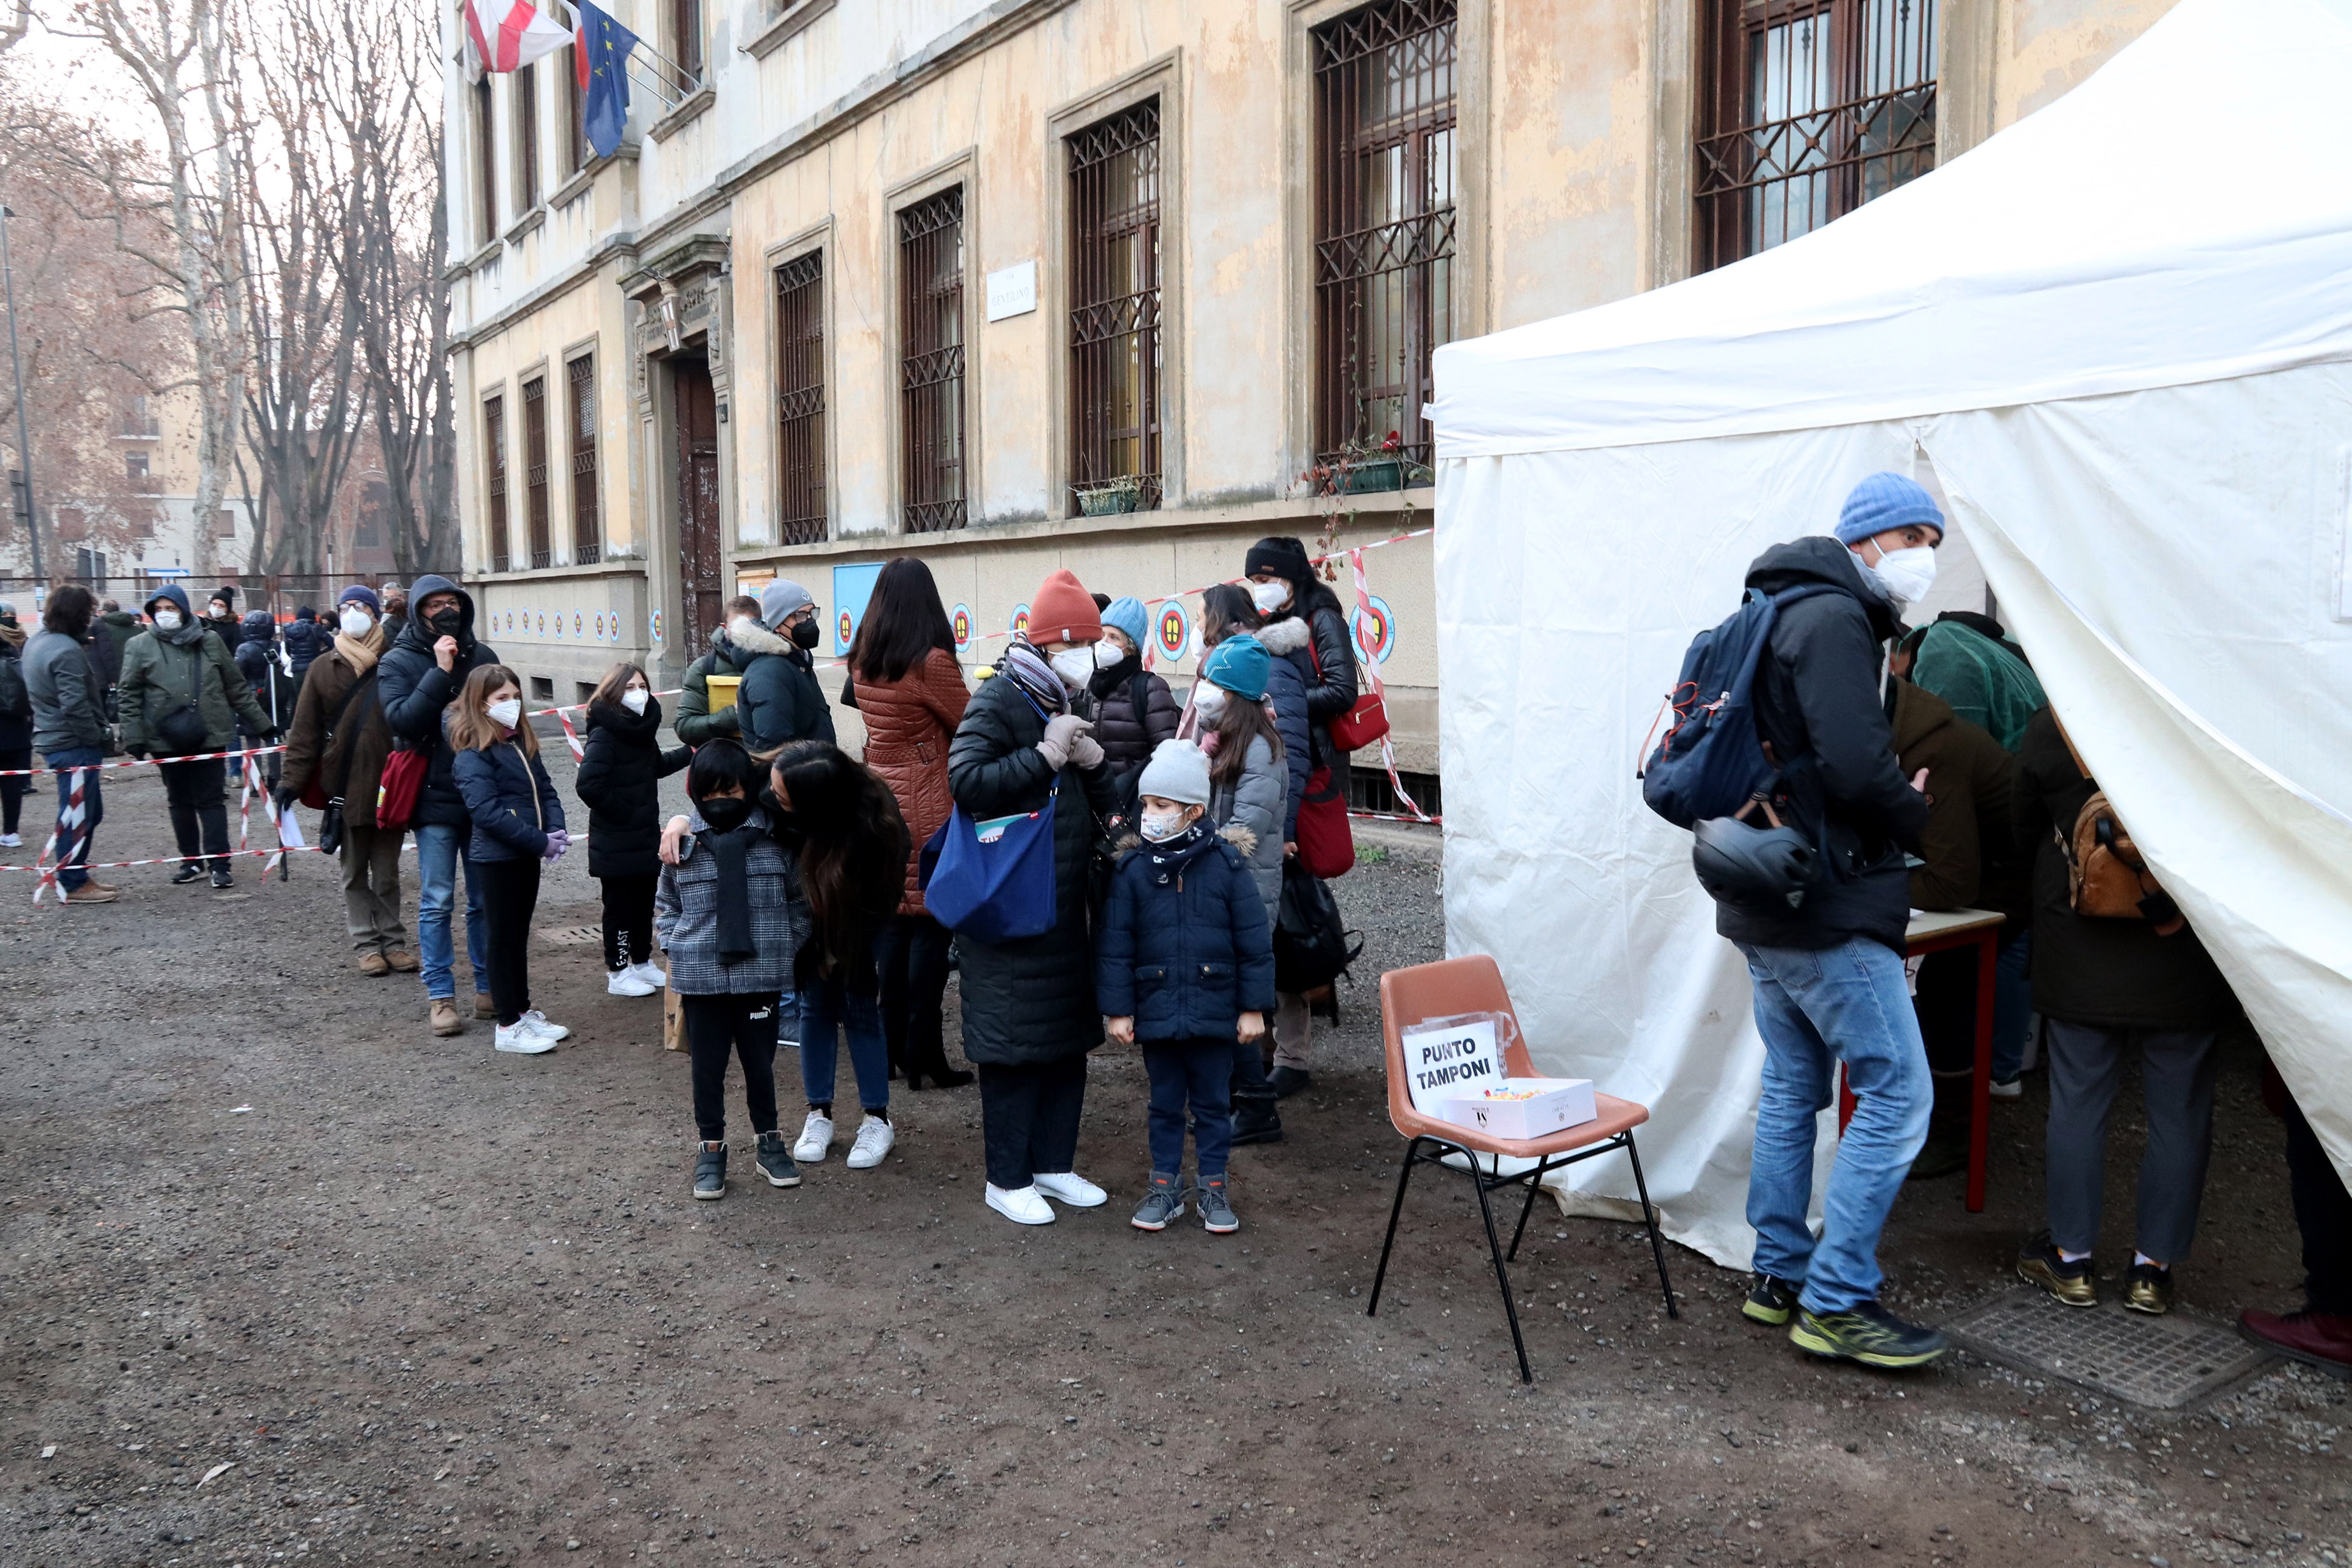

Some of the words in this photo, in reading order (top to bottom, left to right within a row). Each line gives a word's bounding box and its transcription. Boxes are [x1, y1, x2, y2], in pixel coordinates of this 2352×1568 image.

[992, 287, 1030, 307] GENTILINO
[750, 1011, 768, 1020] PUMA
[1422, 1038, 1476, 1064] PUNTO
[1417, 1058, 1491, 1089] TAMPONI
